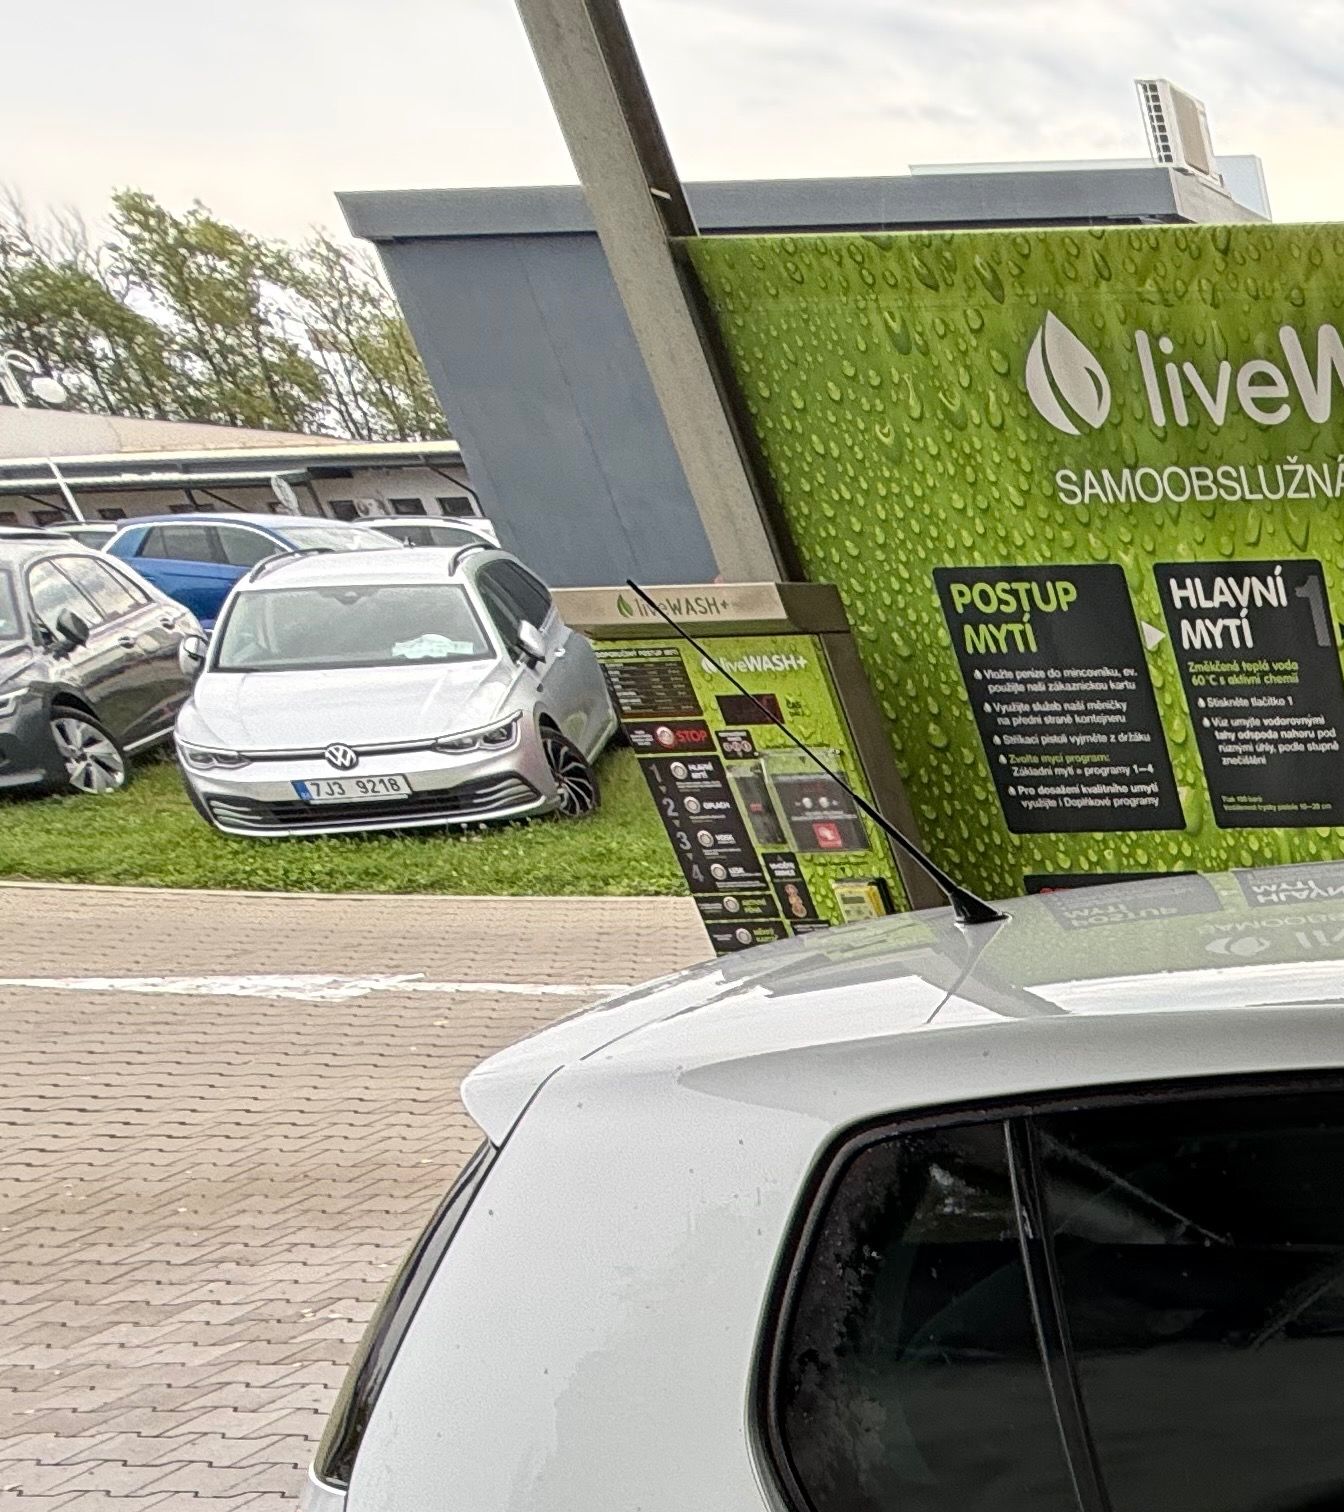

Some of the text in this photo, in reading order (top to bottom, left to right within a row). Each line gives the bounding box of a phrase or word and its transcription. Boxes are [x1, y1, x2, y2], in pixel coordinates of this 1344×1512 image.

[949, 580, 1078, 615] POSTUP
[1170, 564, 1288, 611] HLAVNÍ
[1294, 574, 1332, 648] 1
[964, 614, 1038, 655] MYTÍ
[1181, 608, 1254, 651] MYTÍ
[1272, 658, 1299, 671] voda
[676, 730, 708, 743] STOP
[1317, 727, 1336, 740] pod
[310, 777, 401, 797] 7J3 9218
[662, 797, 679, 817] 2
[676, 831, 692, 850] 3
